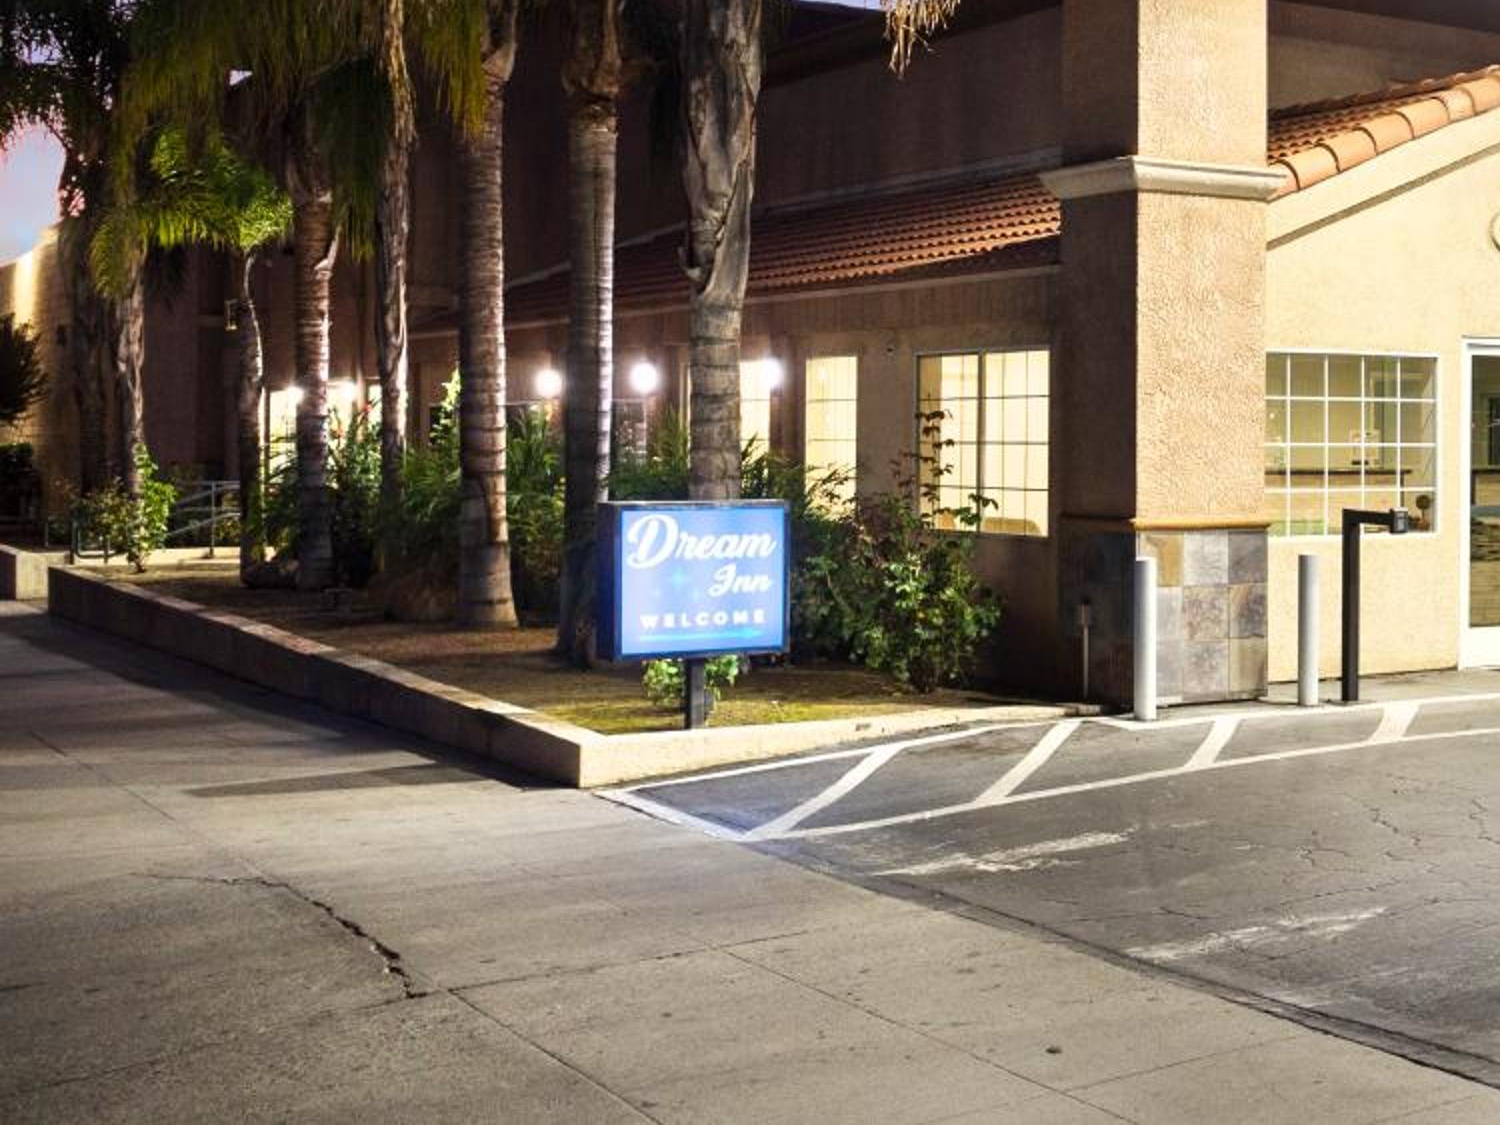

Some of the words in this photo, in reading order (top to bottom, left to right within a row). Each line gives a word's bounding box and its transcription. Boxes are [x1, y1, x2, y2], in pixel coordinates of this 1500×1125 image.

[627, 514, 776, 569] Dream
[708, 563, 772, 597] Inn
[640, 608, 766, 629] WELCOME
